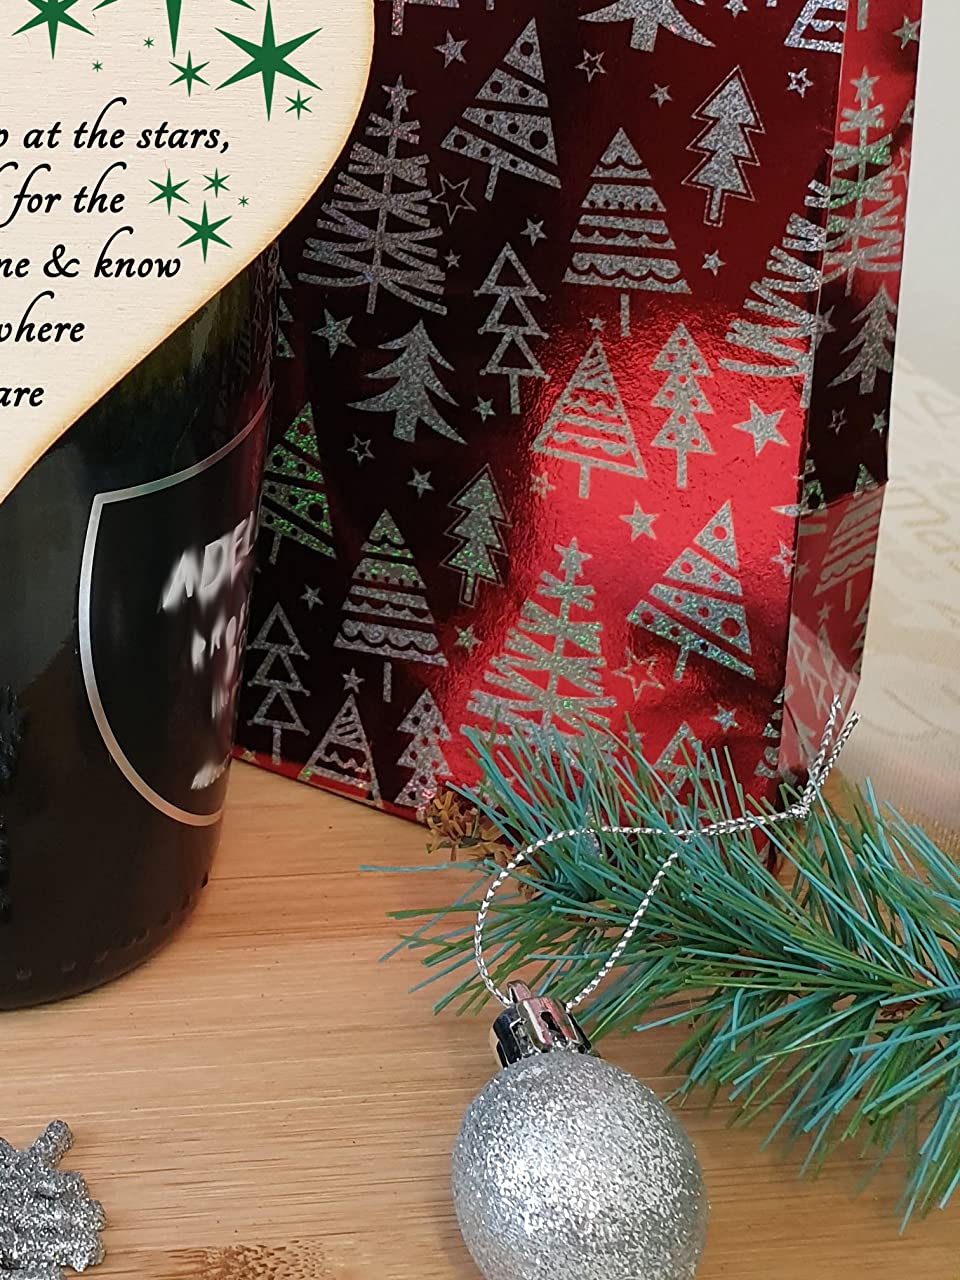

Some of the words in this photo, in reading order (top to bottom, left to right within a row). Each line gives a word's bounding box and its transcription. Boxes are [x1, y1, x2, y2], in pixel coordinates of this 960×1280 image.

[23, 121, 62, 149] at
[73, 96, 128, 149] the
[136, 121, 229, 154] stars,
[73, 161, 127, 214] the
[43, 243, 81, 278] &
[93, 225, 181, 278] know
